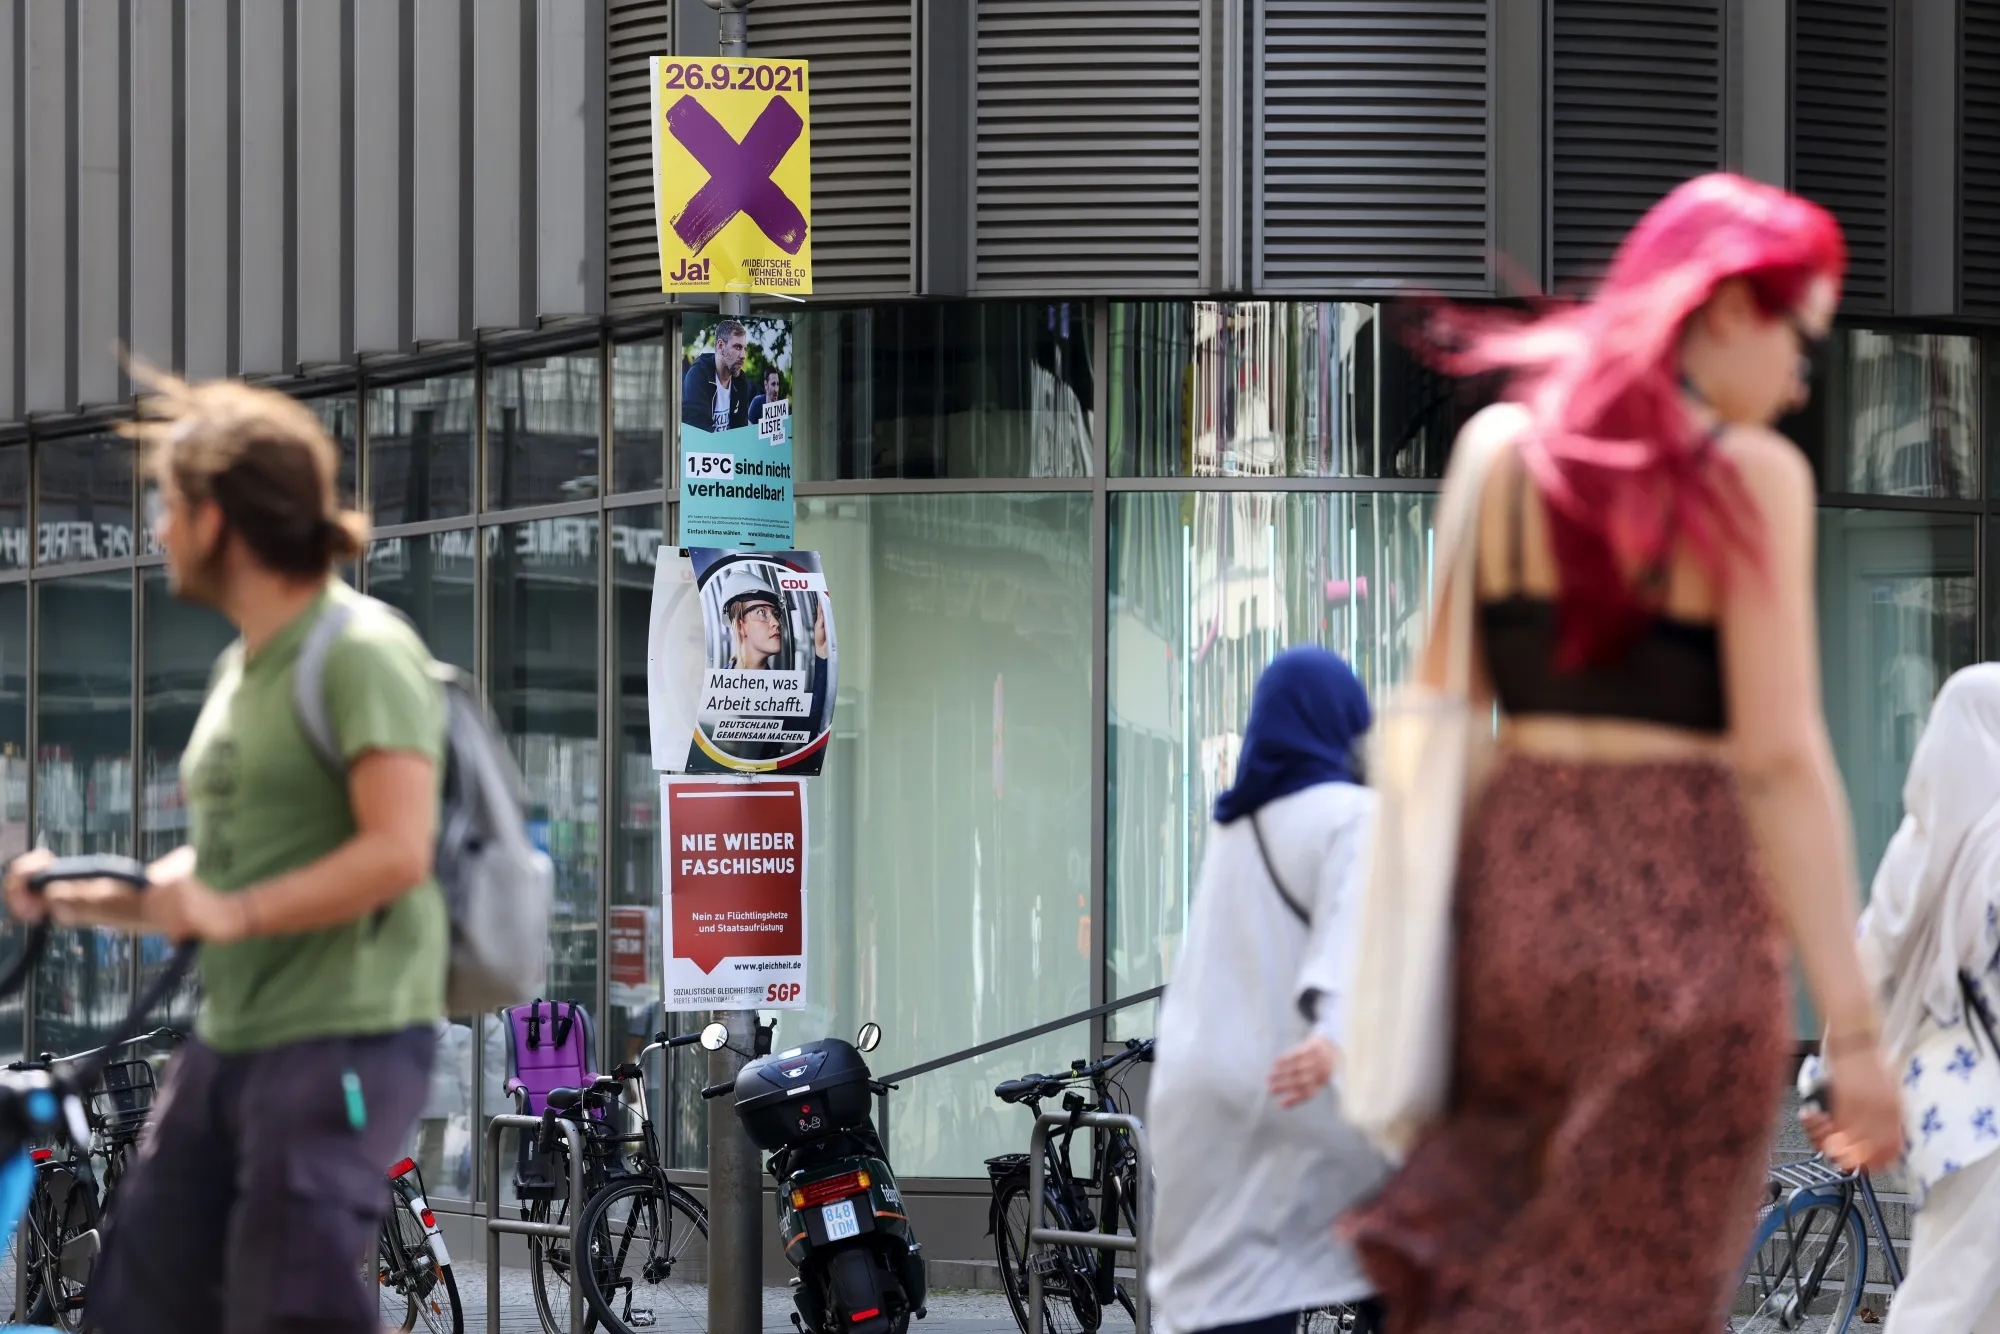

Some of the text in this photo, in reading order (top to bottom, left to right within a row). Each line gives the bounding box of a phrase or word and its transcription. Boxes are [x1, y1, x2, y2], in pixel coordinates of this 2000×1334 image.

[665, 63, 803, 92] 26.9.2021
[670, 258, 710, 281] Ja!
[748, 267, 806, 278] WOHNEN & CO
[754, 277, 801, 286] ENTEIGNEN
[764, 402, 787, 420] KLIMA
[761, 419, 781, 435] LISTE
[772, 432, 784, 442] Berlin
[688, 456, 791, 479] 1,5°C sind nicht
[687, 481, 785, 501] verhandelbar!
[780, 579, 809, 590] CDU
[710, 673, 798, 692] Machen, was
[706, 695, 804, 713] Arbeit schafft.
[718, 720, 780, 730] DEUTSCHLAND
[716, 731, 805, 741] GEMEINSAM MACHEN.
[681, 832, 795, 852] NIE WIEDER
[681, 857, 795, 876] FASCHISMUS
[692, 912, 713, 921] Nein
[727, 911, 789, 922] Flüchtlingshetze
[698, 922, 784, 933] und Staatsaufrüstung
[734, 961, 802, 972] www.gleichheit.de
[673, 986, 716, 996] SOZIALISTISCHE
[766, 983, 801, 1003] SGP
[825, 1204, 851, 1222] 848
